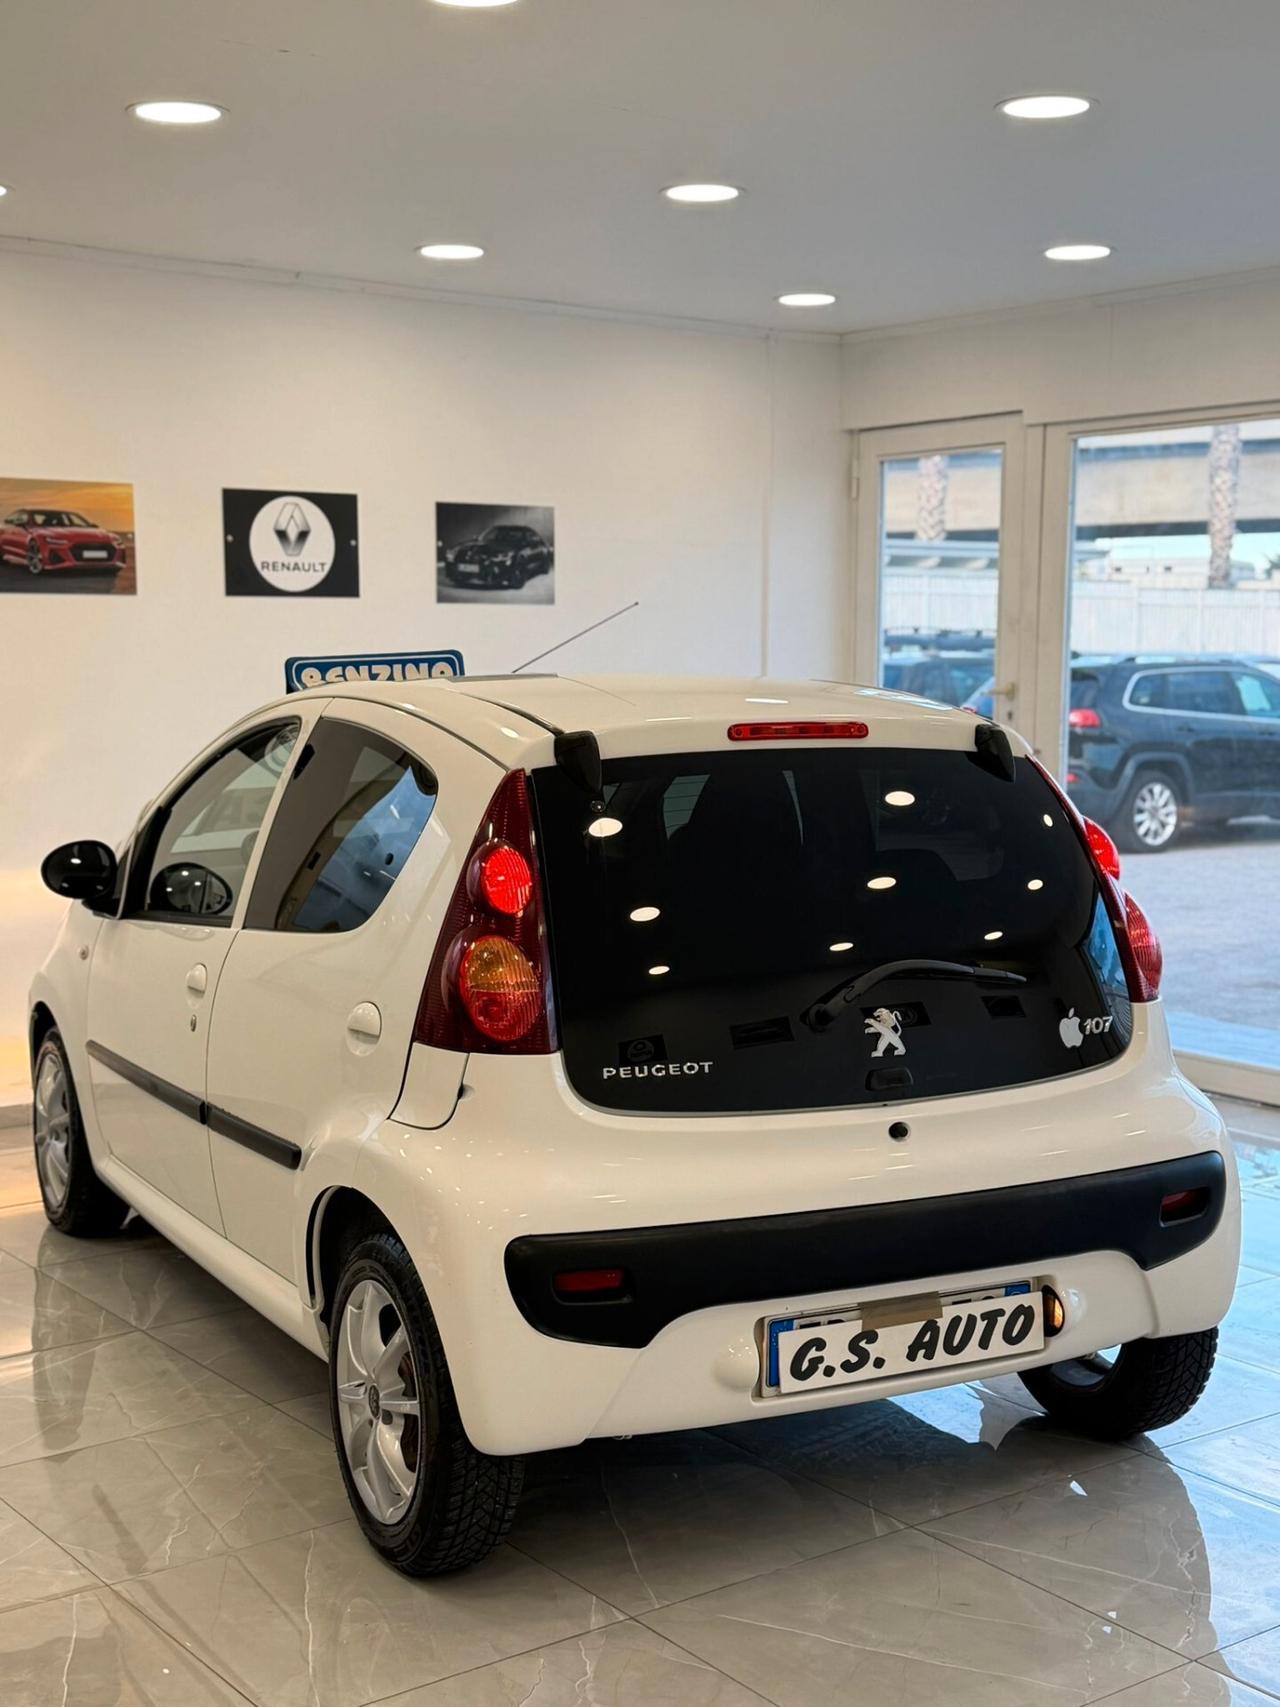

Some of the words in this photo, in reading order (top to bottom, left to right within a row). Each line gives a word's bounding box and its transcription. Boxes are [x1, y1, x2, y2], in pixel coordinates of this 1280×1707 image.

[261, 561, 327, 573] RENAULT
[1083, 1015, 1113, 1035] 107
[602, 1062, 713, 1079] PEUGEOT
[790, 1329, 886, 1381] G.S.
[905, 1304, 1035, 1362] AUTO
